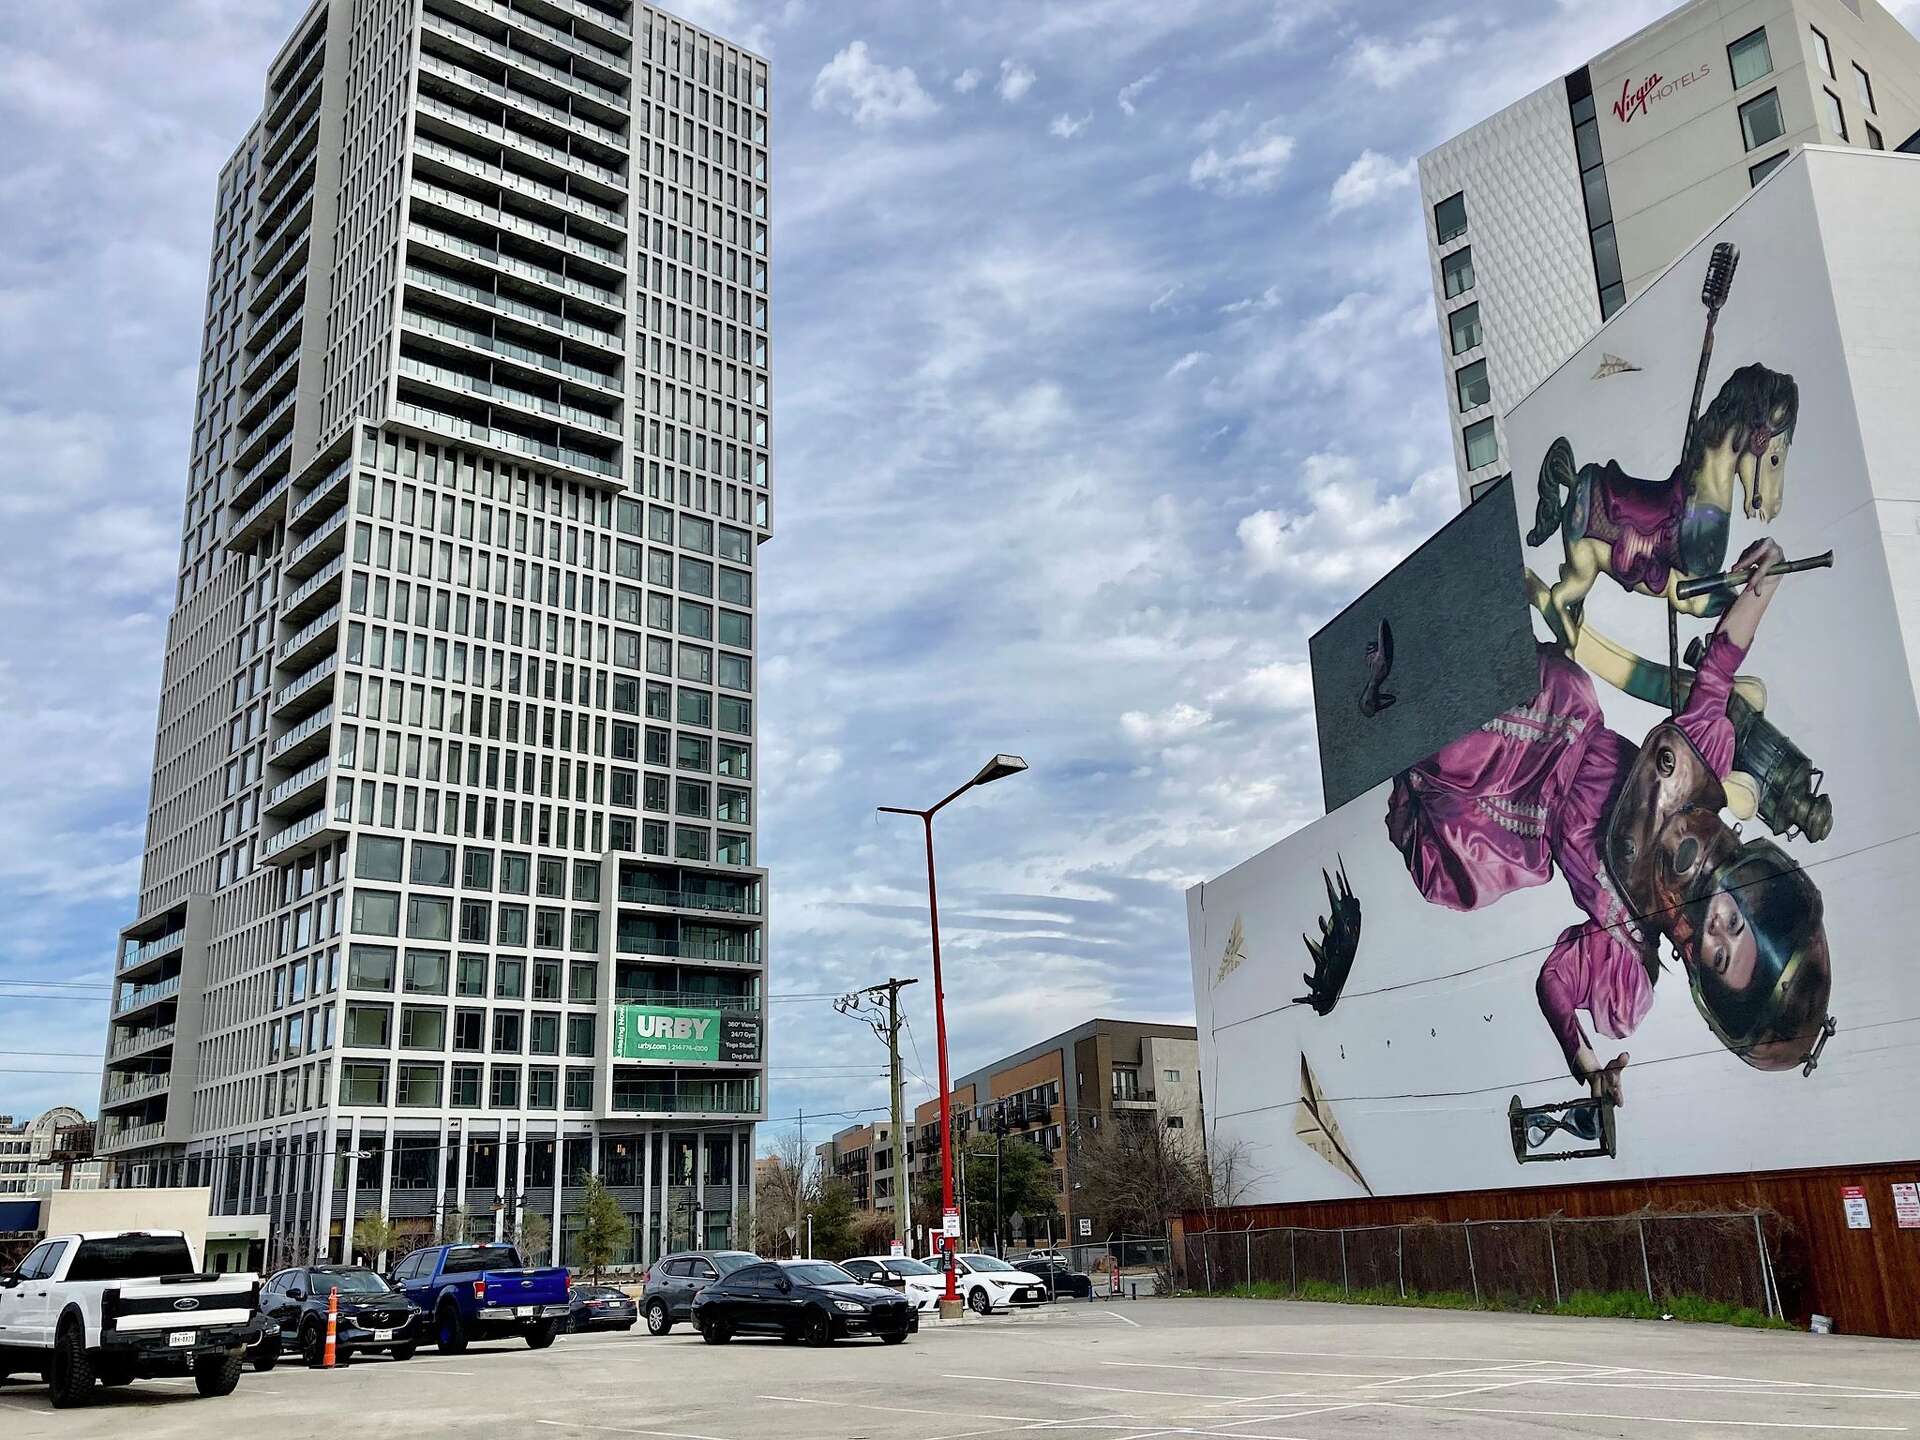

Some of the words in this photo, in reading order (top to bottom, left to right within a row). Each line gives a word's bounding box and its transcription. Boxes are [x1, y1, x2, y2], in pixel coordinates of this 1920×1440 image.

[1613, 73, 1663, 122] Virgin
[1649, 63, 1710, 105] HOTELS
[637, 1015, 712, 1040] URBY
[638, 1042, 667, 1051] urby.com
[725, 1041, 739, 1049] Yoga
